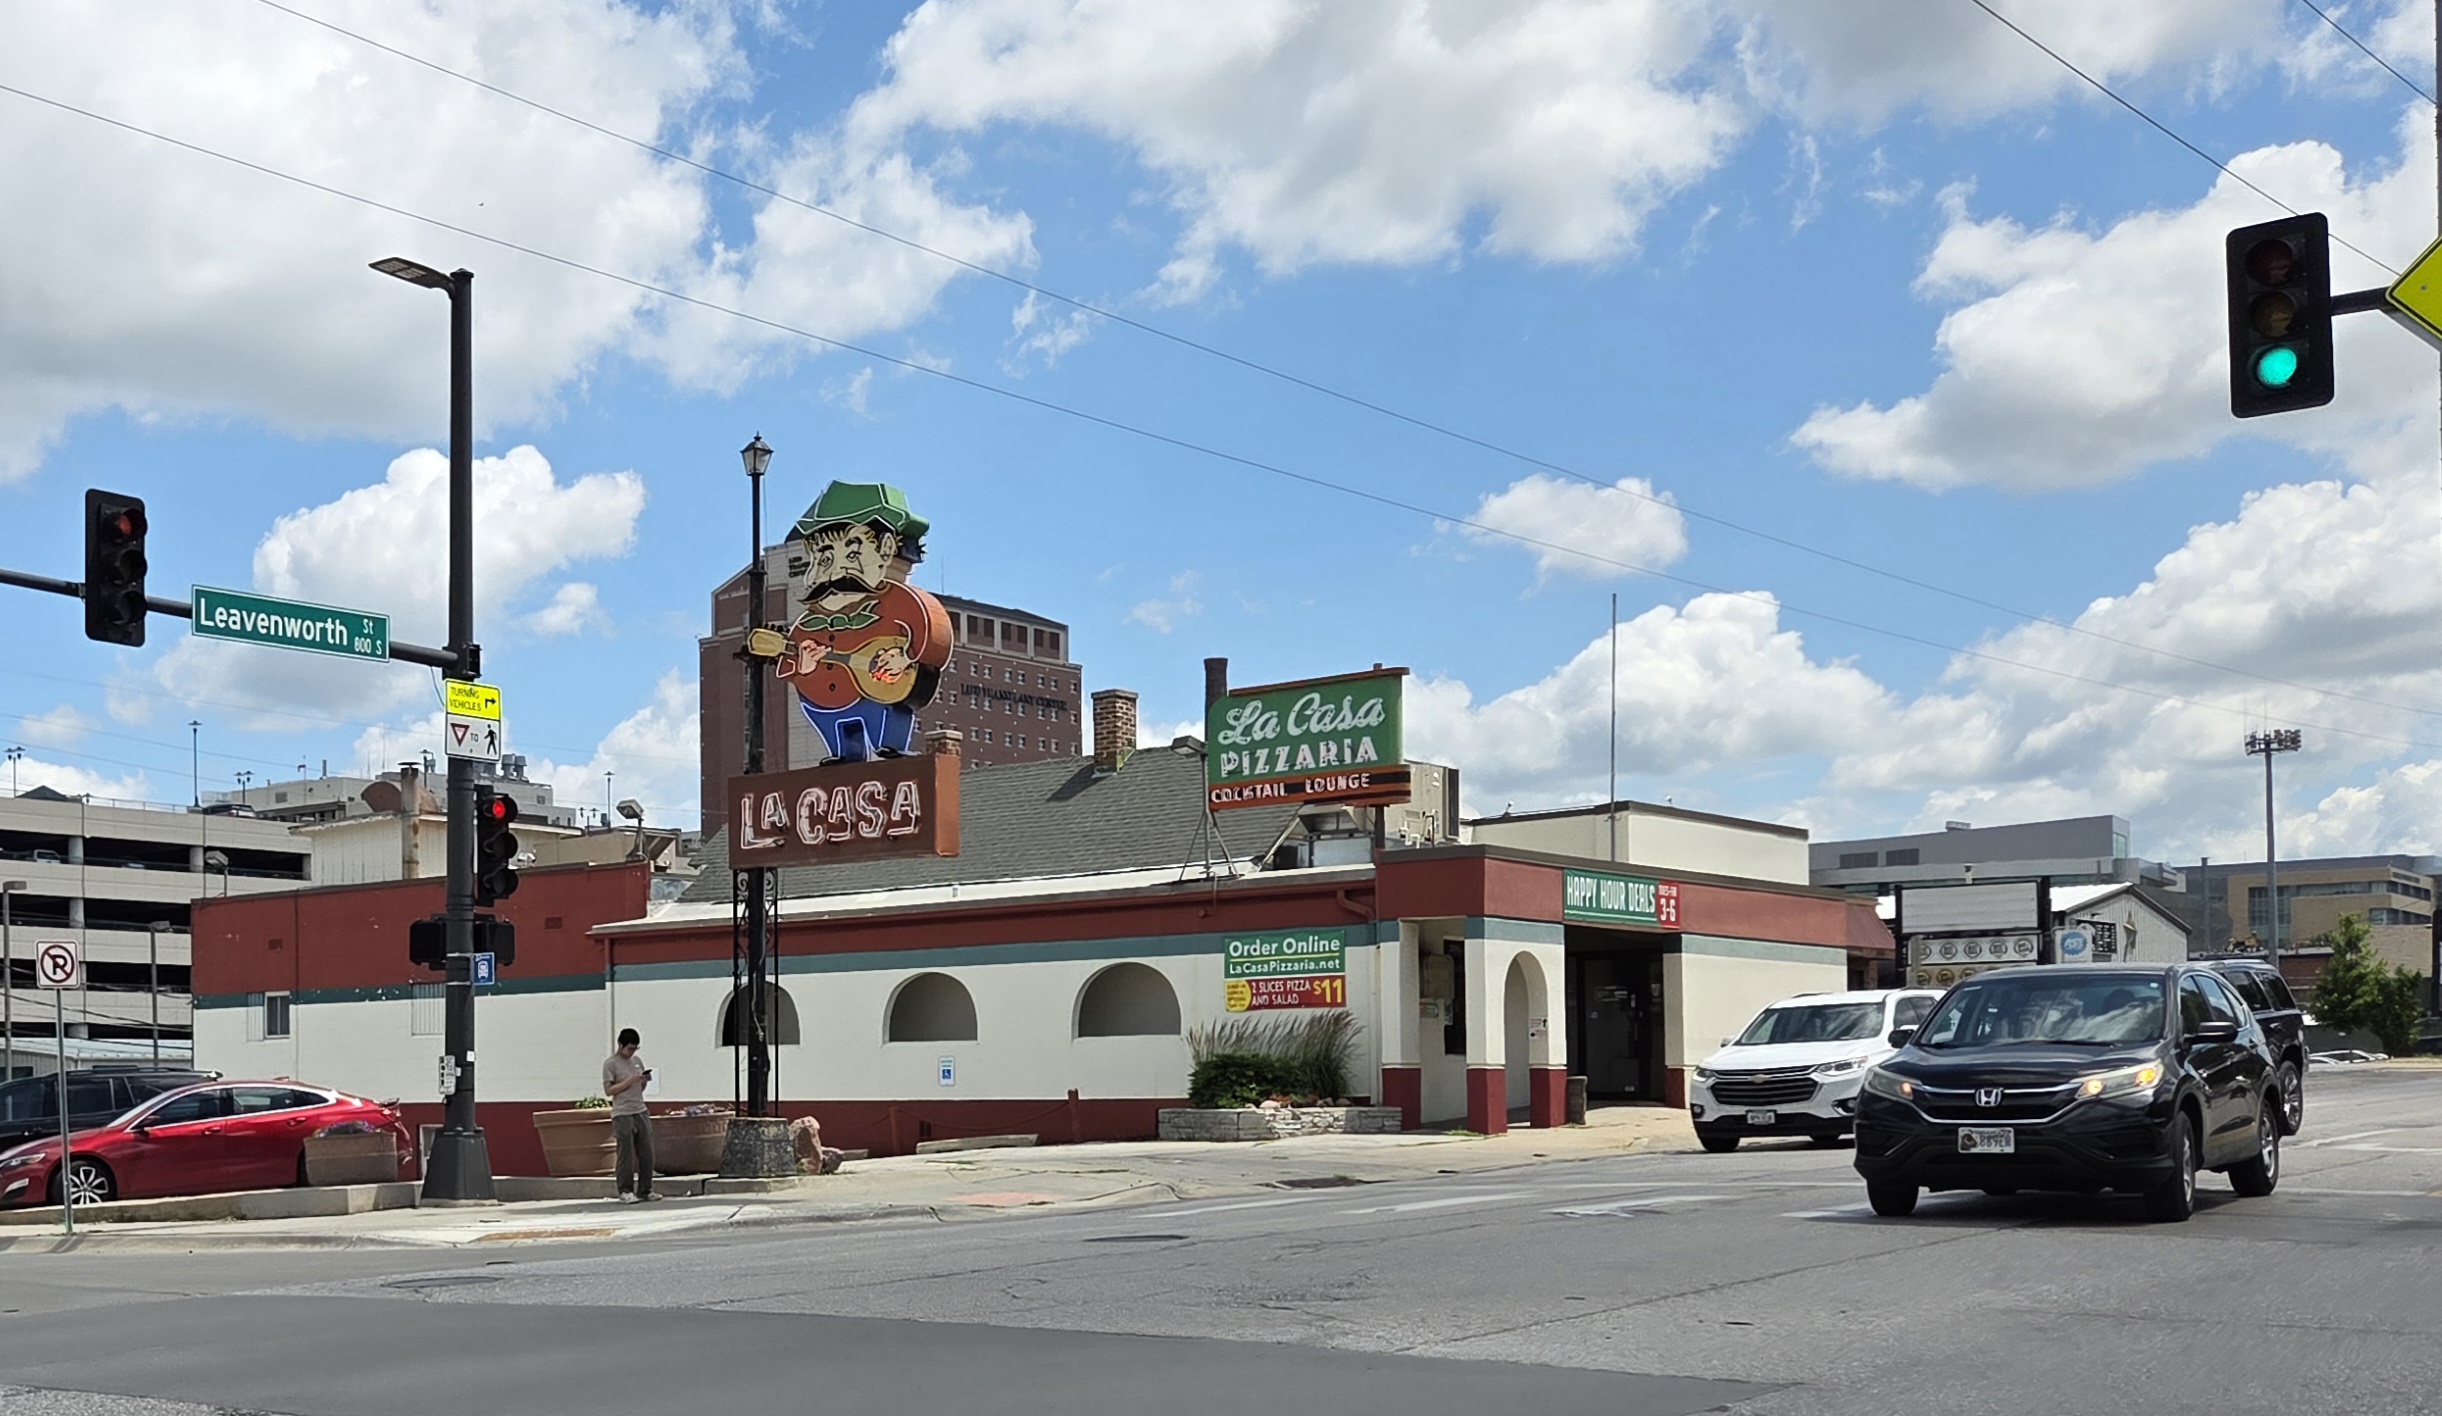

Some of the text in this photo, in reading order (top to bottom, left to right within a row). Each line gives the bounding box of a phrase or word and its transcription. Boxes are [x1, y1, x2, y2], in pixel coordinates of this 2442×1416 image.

[200, 598, 374, 646] Leavenworth St
[354, 637, 382, 655] 800 S
[449, 698, 482, 711] VEHICLES
[450, 686, 480, 699] TURNING
[1218, 692, 1386, 745] La Casa
[1220, 736, 1378, 778] PIZZARIA
[1211, 773, 1371, 803] COCKTAIL LOUNGE
[741, 780, 922, 849] LA CASA
[1566, 875, 1598, 908] HAPPY
[1600, 879, 1626, 911] HOUR
[1628, 882, 1656, 913] DEALS
[1660, 897, 1676, 922] 3-6
[1229, 935, 1340, 957] Order Online
[1229, 958, 1340, 974] LaCasaPizzaria.net
[1251, 979, 1342, 1003] 2 SLICES PIZZA $11
[1251, 995, 1269, 1006] AND
[1272, 993, 1299, 1005] SALAD
